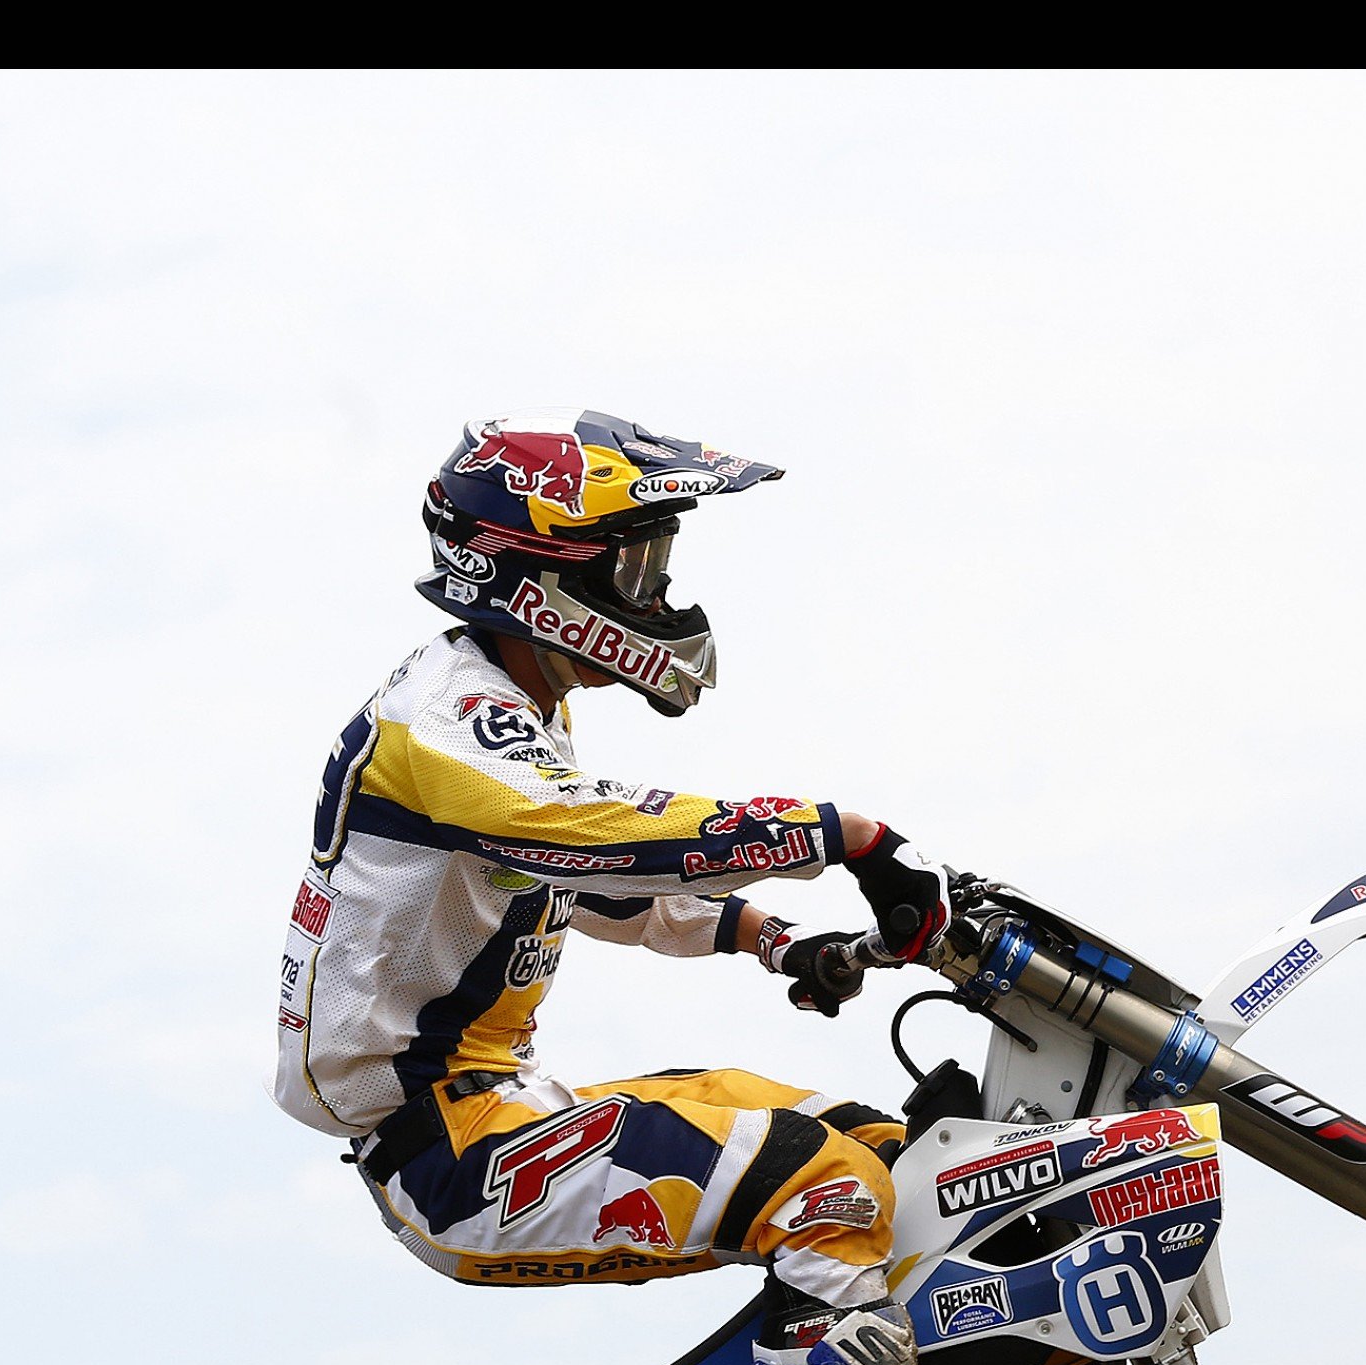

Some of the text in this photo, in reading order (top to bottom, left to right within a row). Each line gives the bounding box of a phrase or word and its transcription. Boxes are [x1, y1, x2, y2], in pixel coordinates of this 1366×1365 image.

[638, 479, 717, 494] SUOMY
[508, 580, 672, 687] Red Bull
[478, 839, 636, 870] PROGRIP
[684, 826, 811, 876] Red Bull
[1233, 940, 1315, 1015] LEMMENS
[1244, 952, 1324, 1024] METAALBEWERKING
[995, 1121, 1073, 1145] TONKOV
[959, 1165, 977, 1174] METAL
[979, 1158, 998, 1167] PARTS
[941, 1157, 1056, 1211] WILVO
[474, 1253, 699, 1279] PROGRIP
[952, 1312, 996, 1327] PERFORMANCE
[963, 1309, 983, 1318] TOTAL
